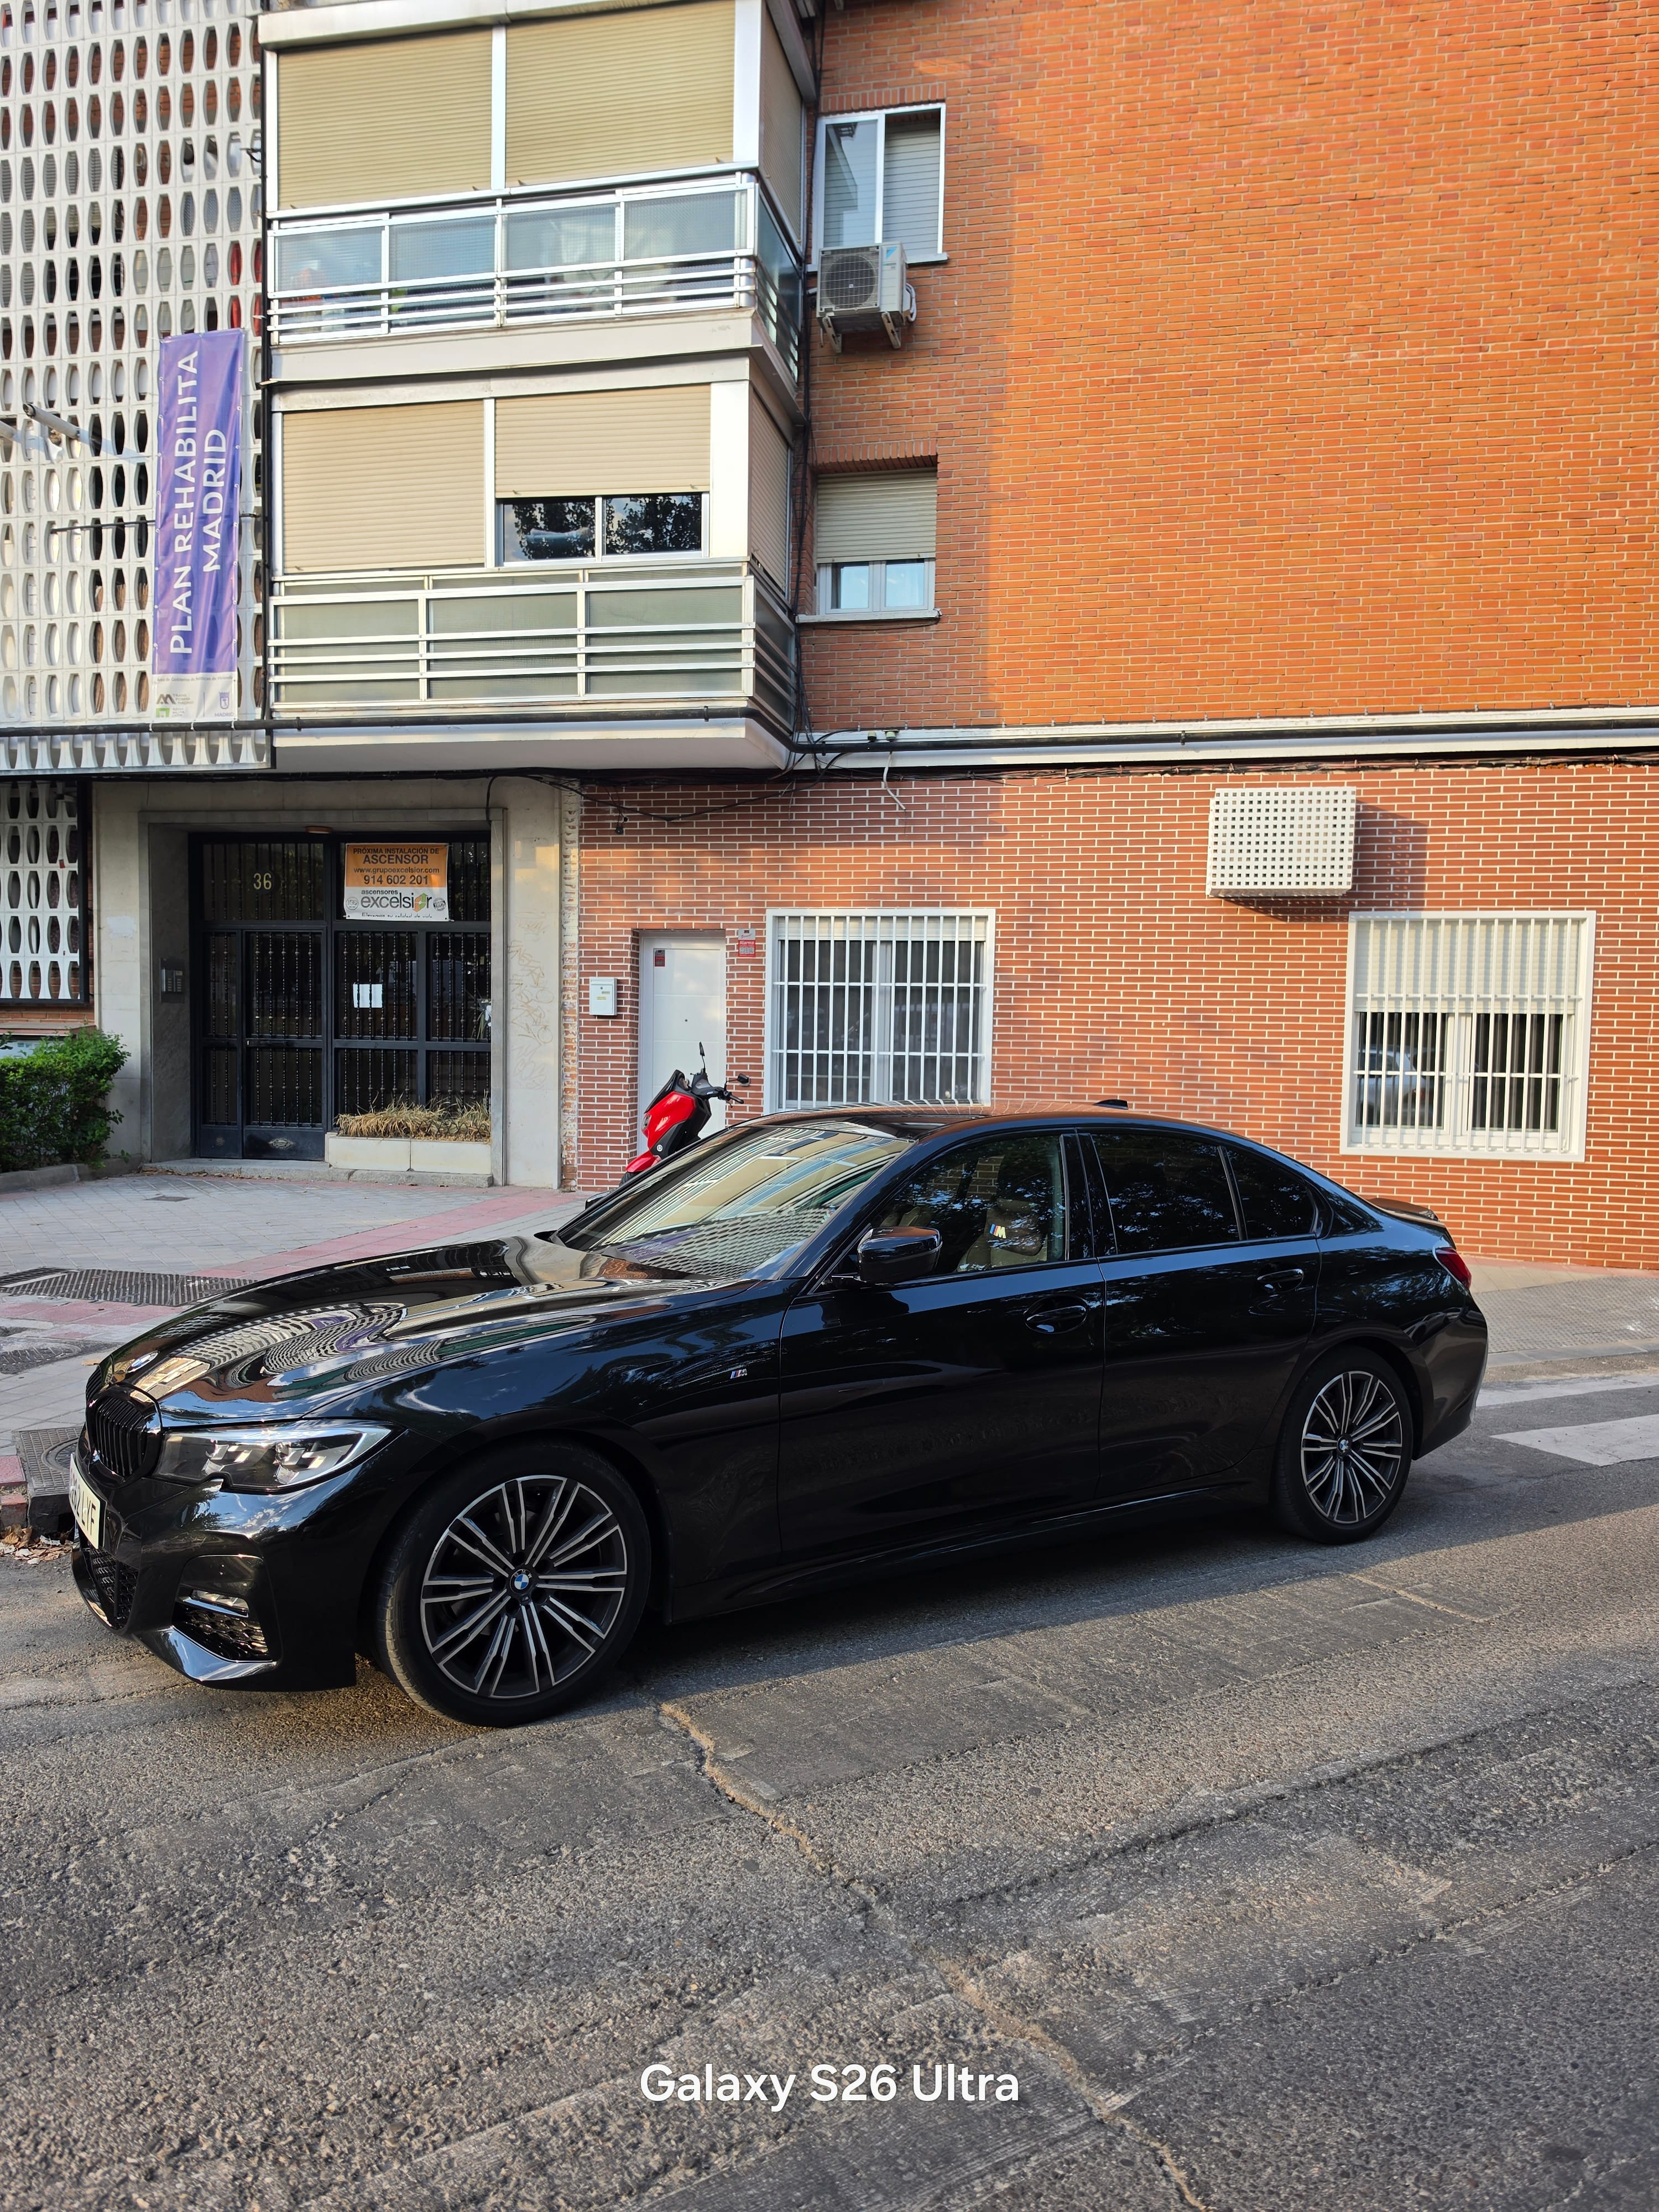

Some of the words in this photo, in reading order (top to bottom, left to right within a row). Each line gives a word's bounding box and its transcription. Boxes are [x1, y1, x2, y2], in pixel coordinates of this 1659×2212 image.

[175, 350, 199, 552] REHABILITA
[203, 428, 227, 572] MADRID
[170, 566, 192, 655] PLAN
[253, 873, 272, 890] 36
[363, 854, 429, 864] ASCENSOR
[364, 875, 383, 885] 914
[387, 875, 406, 885] 602
[410, 875, 429, 885] 201
[82, 1490, 96, 1536] LYF
